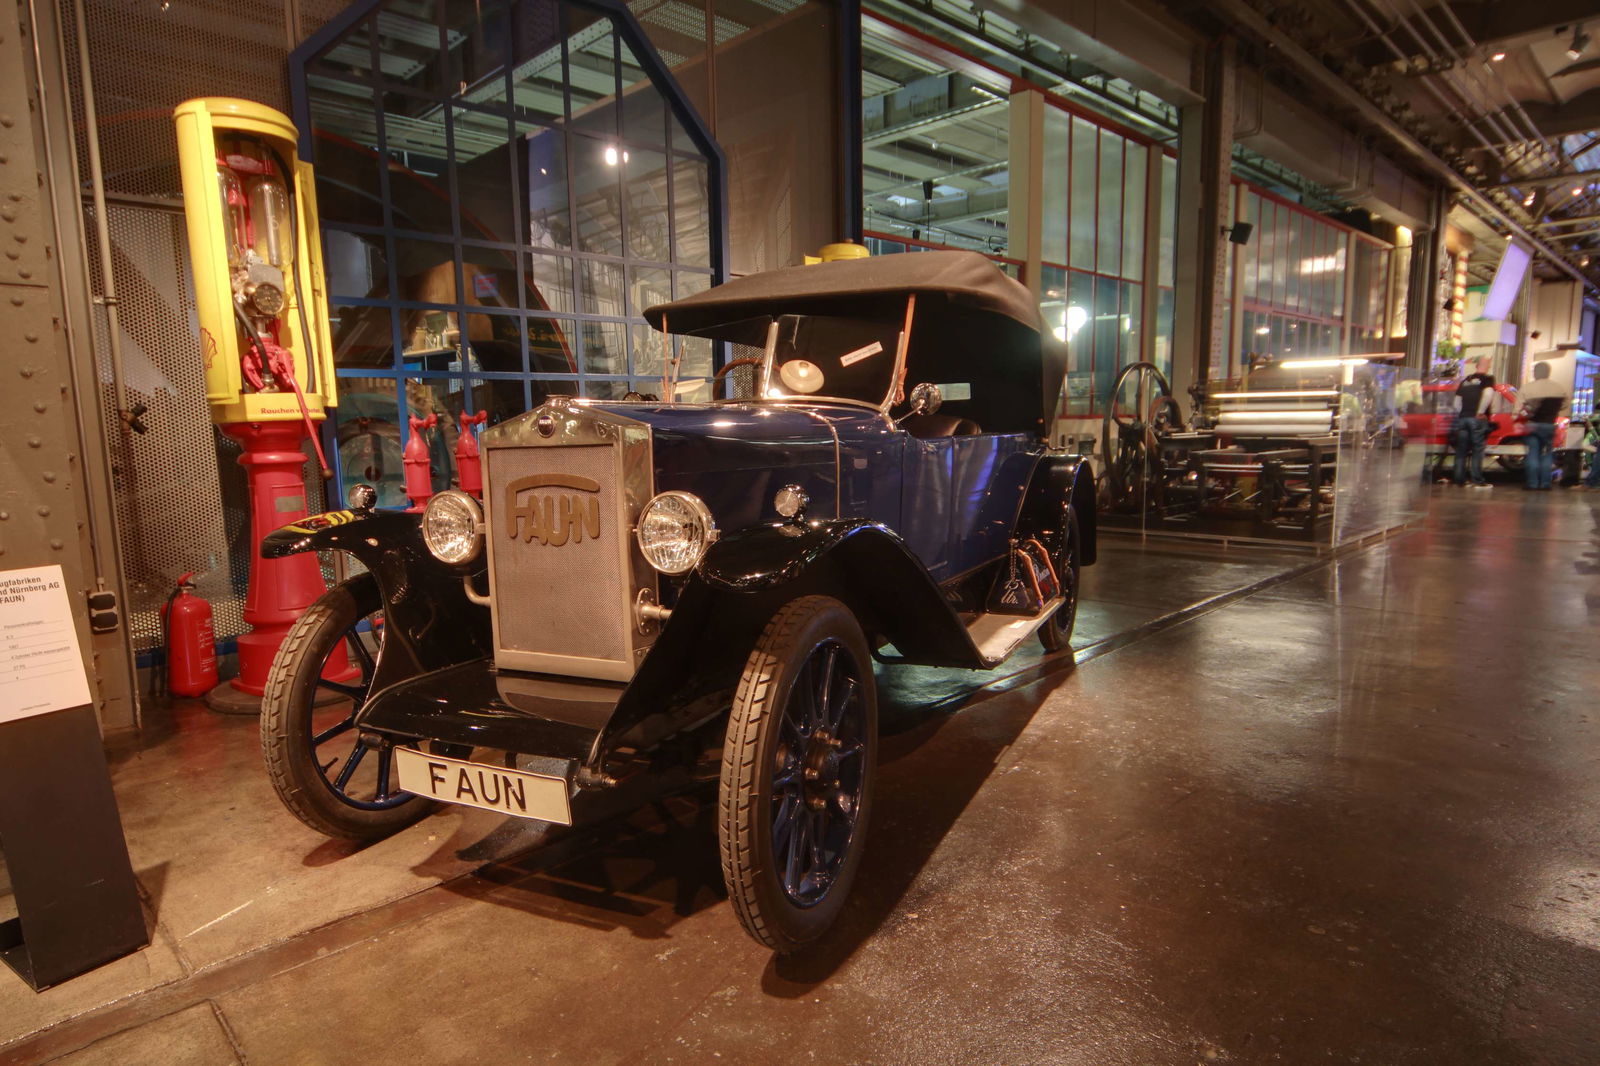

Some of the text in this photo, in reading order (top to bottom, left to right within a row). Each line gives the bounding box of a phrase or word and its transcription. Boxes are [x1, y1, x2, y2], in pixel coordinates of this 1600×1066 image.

[260, 407, 295, 415] Rauchen
[505, 473, 600, 547] FAUN
[9, 584, 47, 594] Nürnberg
[48, 581, 60, 589] AG
